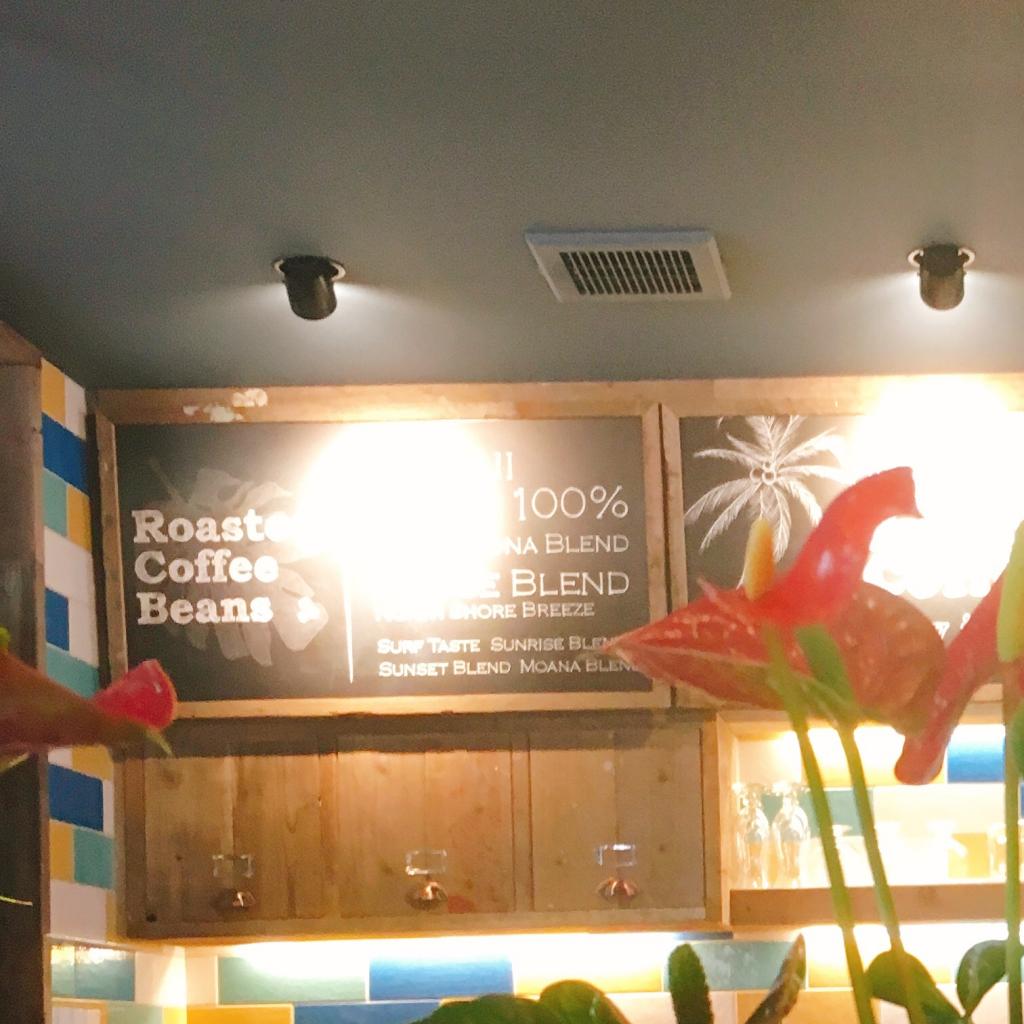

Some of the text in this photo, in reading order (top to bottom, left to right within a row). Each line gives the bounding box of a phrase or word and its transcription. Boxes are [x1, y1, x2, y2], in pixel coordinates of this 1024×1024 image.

[513, 484, 629, 521] 100%
[545, 533, 629, 554] BLEND
[134, 548, 280, 584] Coffee
[511, 568, 630, 598] BLEND
[135, 591, 274, 625] Beans
[522, 600, 595, 618] BREEZE
[427, 637, 481, 654] TASTE
[490, 636, 565, 652] SUNRISE
[378, 658, 640, 677] SUNSET BLEND MOANA BLEN
